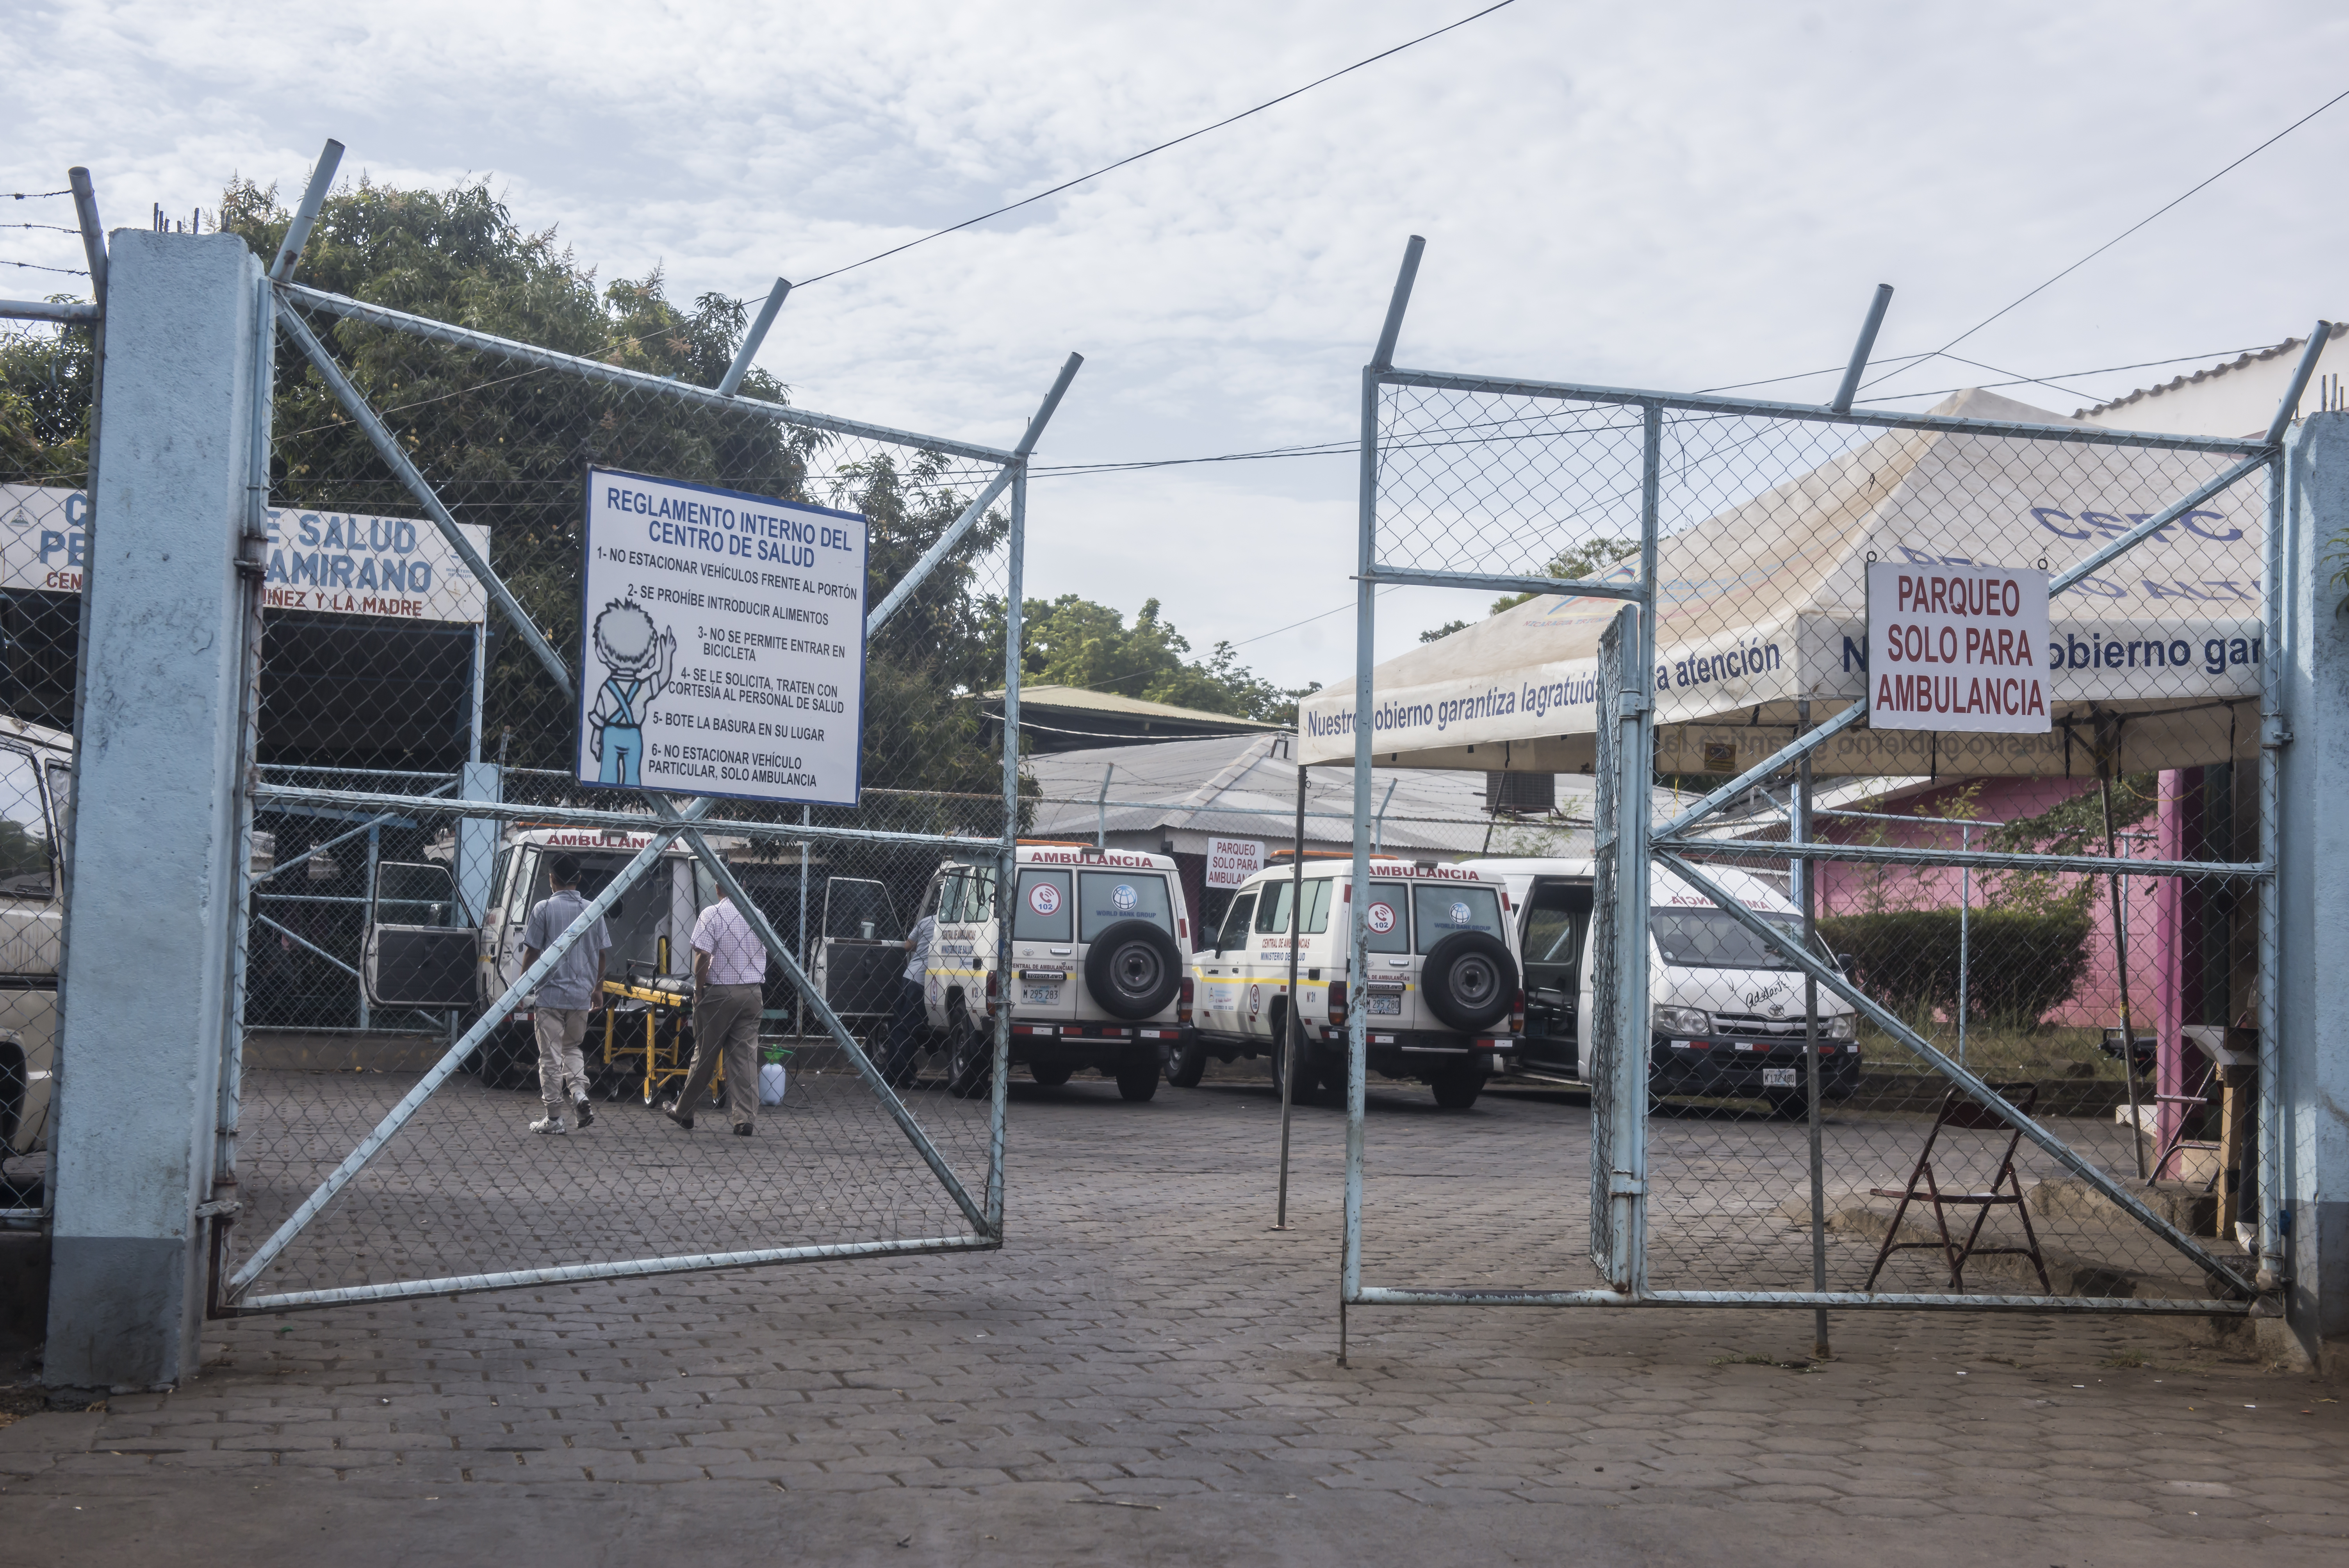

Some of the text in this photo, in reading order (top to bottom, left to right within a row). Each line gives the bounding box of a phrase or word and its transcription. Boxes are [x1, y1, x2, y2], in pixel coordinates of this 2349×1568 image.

[608, 487, 852, 551] REGLAMENTO INTERNO DEL
[299, 514, 416, 554] SALUD
[649, 520, 814, 568] CENTRO DE SALUD
[597, 547, 857, 600] 1- NO ESTACIONAR VEHÍCULOS FRENTE AL PORTÓN
[1898, 575, 2021, 618] PARQUEO
[2140, 580, 2260, 600] ALT
[315, 593, 324, 608] Y
[333, 595, 354, 611] LA
[363, 597, 422, 616] MADRE
[628, 584, 829, 626] 2- SE PROHÍBE INTRODUCIR ALIMENTOS
[698, 626, 845, 658] 3- NO SE PERMITE ENTRAR EN
[703, 643, 756, 661] BICICLETA
[1888, 624, 2033, 666] SOLO PARA
[681, 667, 838, 698] 4- SE LE SOLICITA, TRATEN CON
[1372, 701, 1433, 732] obierno
[1438, 686, 1515, 731] garantiza
[1521, 670, 1597, 718] lagratuid
[1654, 659, 1670, 691] a
[1676, 637, 1780, 687] atención
[1876, 674, 2045, 716] AMBULANCIA
[668, 681, 844, 714] CORTESÍA AL PERSONAL DE SALUD
[653, 711, 825, 742] 5- BOTE LA BASURA EN SU LUGAR
[652, 743, 802, 770] 6- NO ESTACIONAR VEHÍCULO
[649, 760, 816, 787] PARTICULAR, SOLO AMBULANCIA
[547, 834, 679, 850] AMBULANA
[1217, 842, 1255, 856] PARQUEO
[1031, 852, 1153, 867] AMBULANCIA
[1213, 857, 1258, 871] SOLO PARA
[1369, 866, 1479, 880] AMBULANCIA
[1208, 871, 1252, 884] AMBULAN
[958, 946, 962, 954] DE
[1260, 952, 1284, 960] MINISTERIO
[1262, 939, 1277, 948] CENTRAL
[1278, 938, 1284, 948] DE
[1023, 989, 1058, 999] M 295 283
[1367, 1000, 1399, 1009] M 295 280
